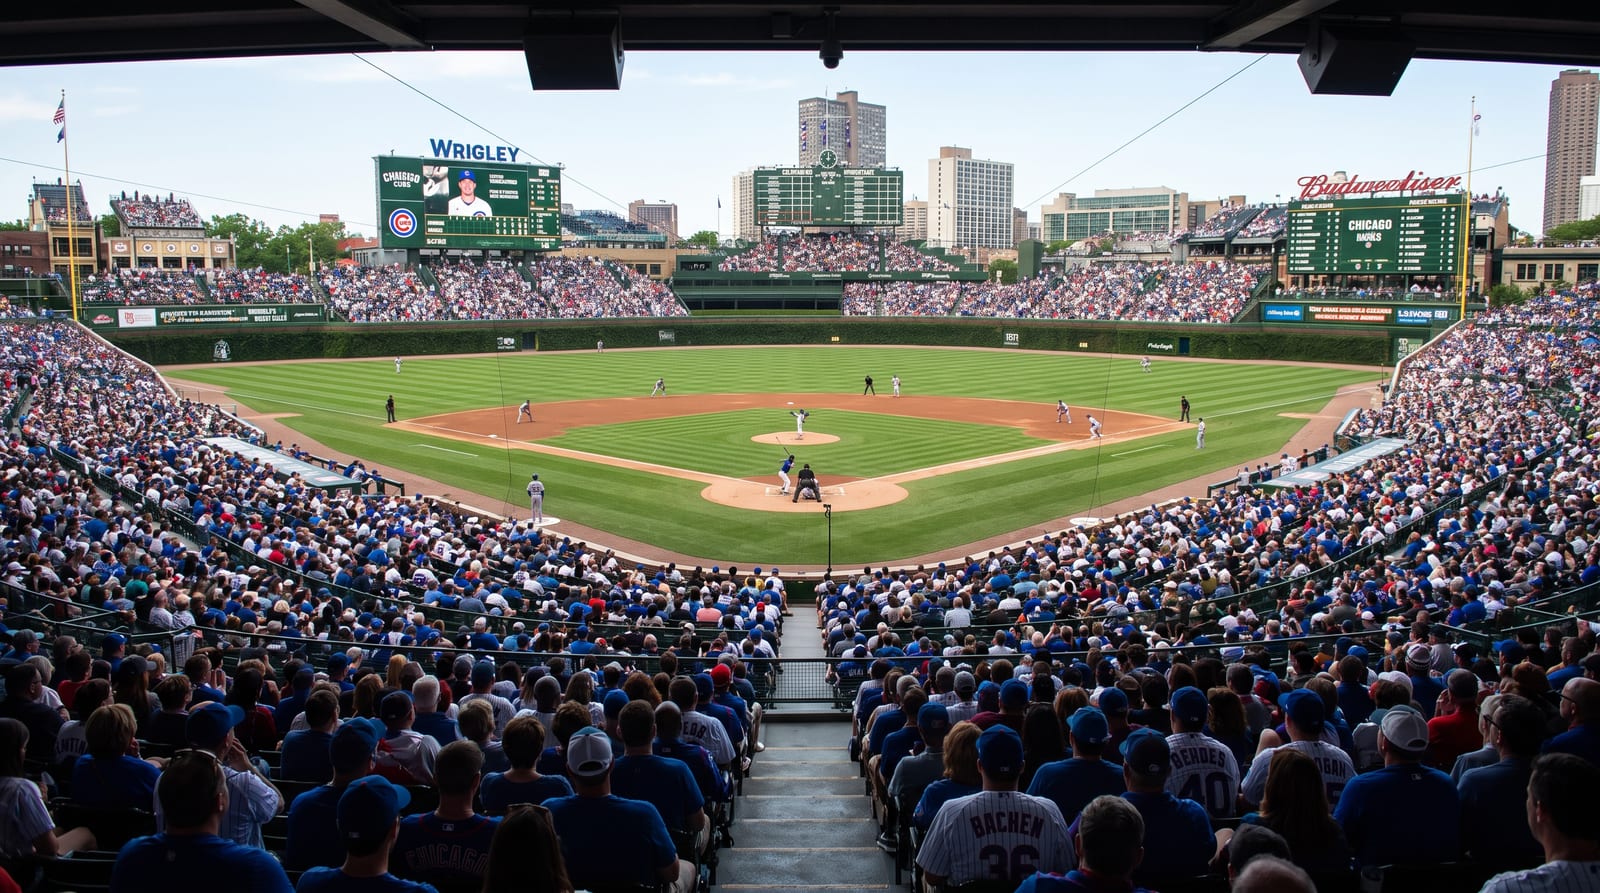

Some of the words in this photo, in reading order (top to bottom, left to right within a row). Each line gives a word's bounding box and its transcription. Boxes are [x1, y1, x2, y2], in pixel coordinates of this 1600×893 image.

[430, 138, 520, 162] WRIGLEY
[1348, 219, 1392, 231] CHICAGO
[1178, 772, 1231, 818] 40
[970, 811, 1044, 839] BACHEN
[979, 844, 1040, 882] 36
